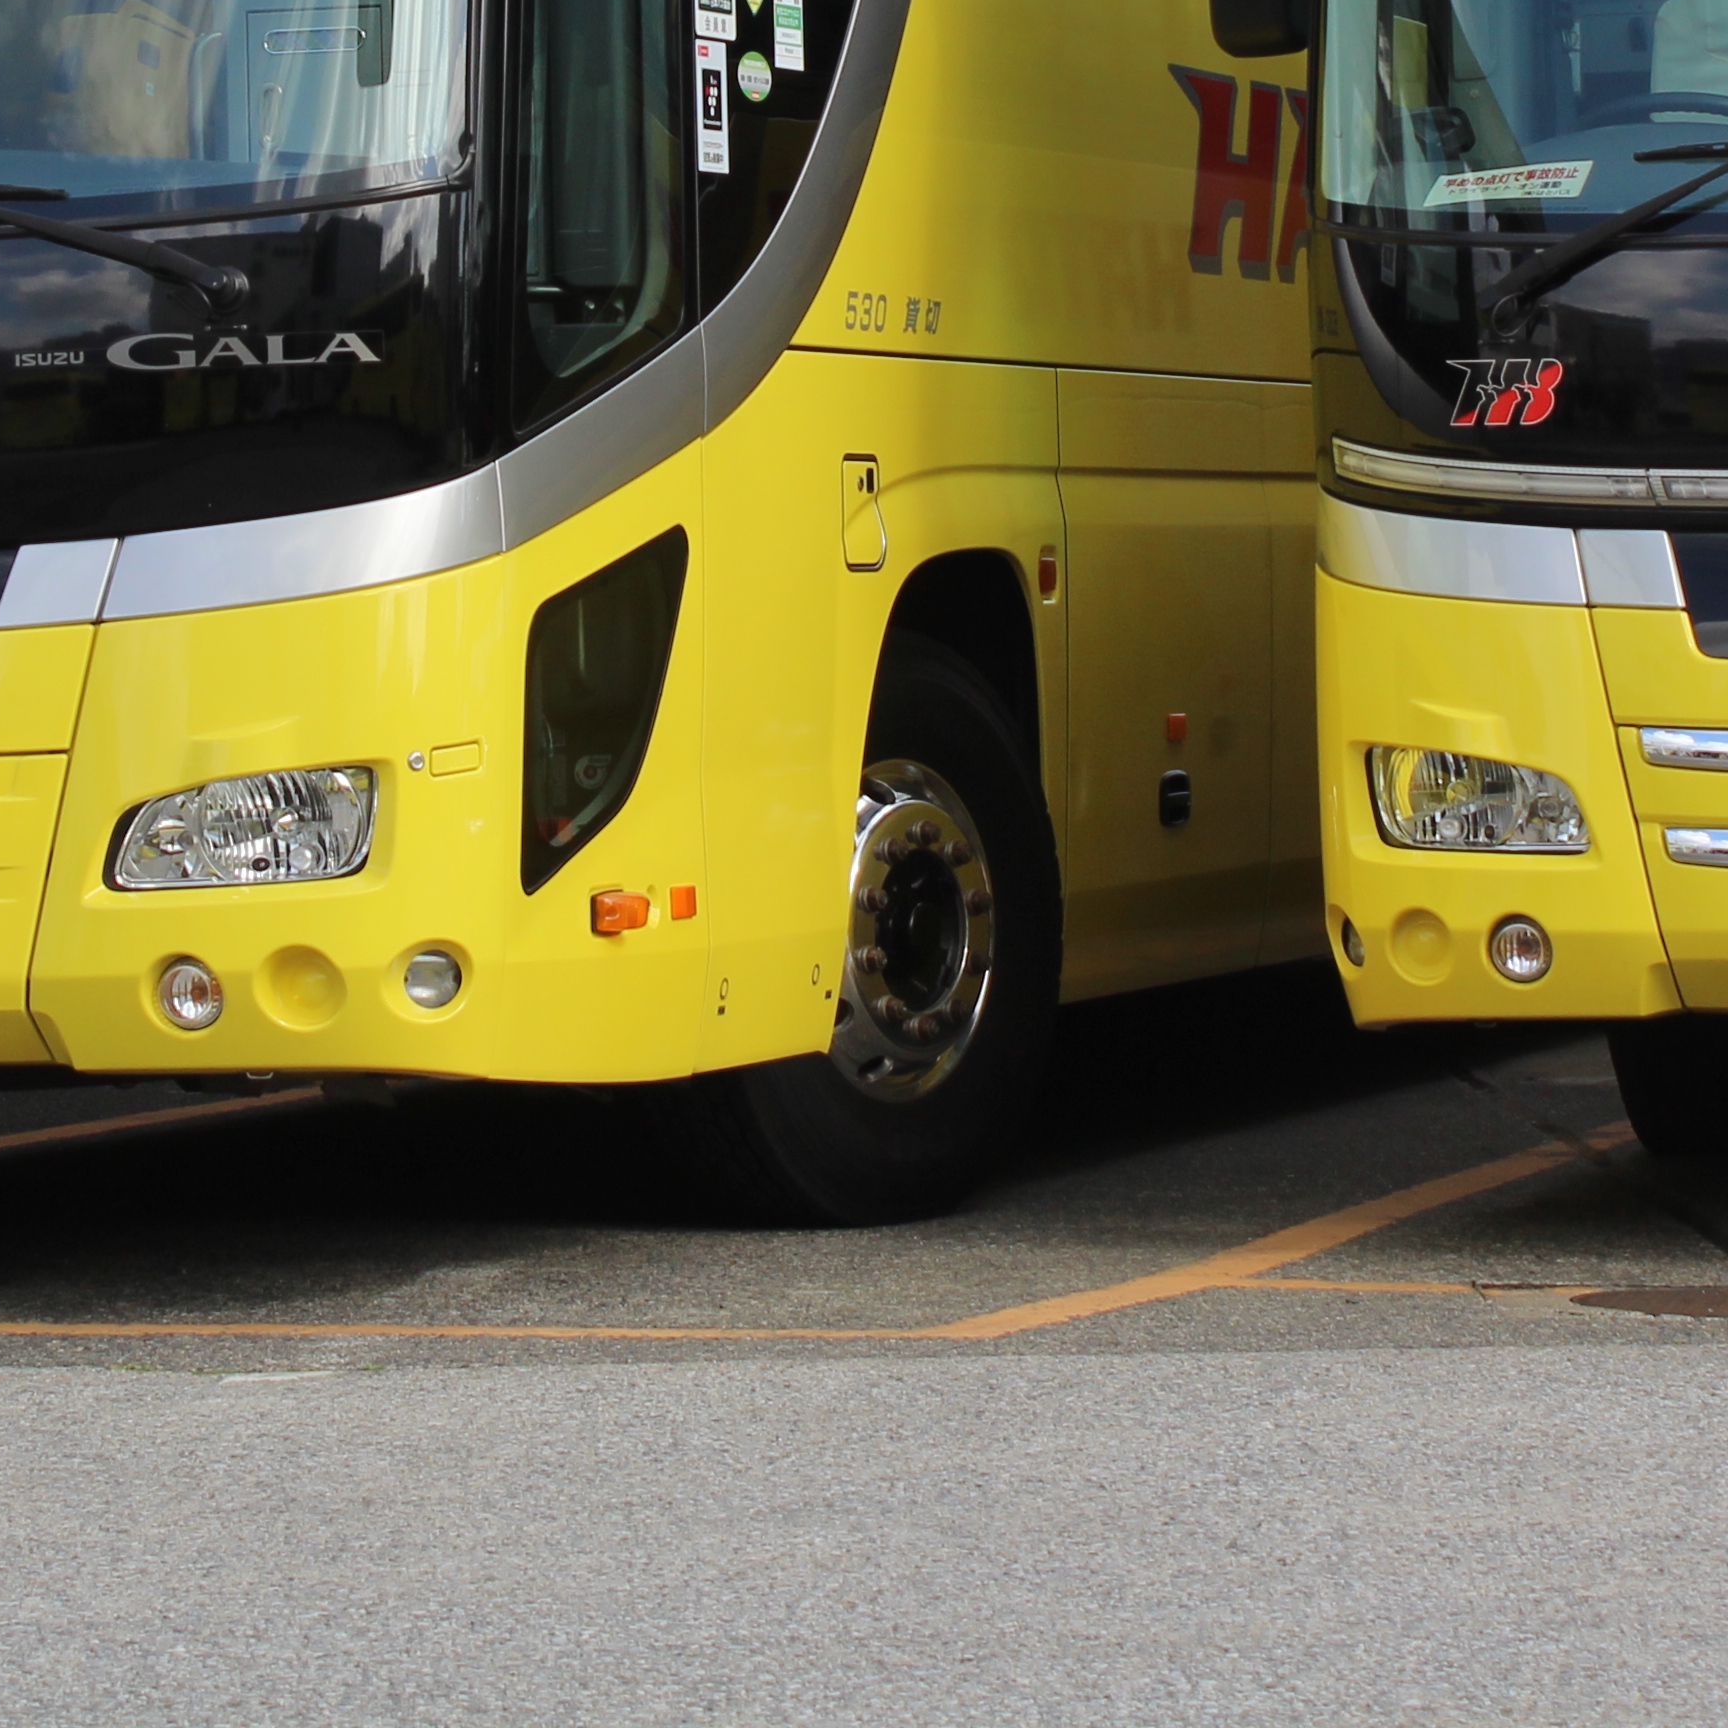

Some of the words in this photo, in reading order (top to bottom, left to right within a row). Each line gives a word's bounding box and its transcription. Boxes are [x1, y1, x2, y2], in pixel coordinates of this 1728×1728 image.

[1444, 167, 1580, 187] 早めの点灯で事故防止
[845, 291, 887, 332] 530
[903, 296, 941, 334] 貸切
[15, 352, 84, 367] ISUZU
[106, 333, 381, 371] GALA
